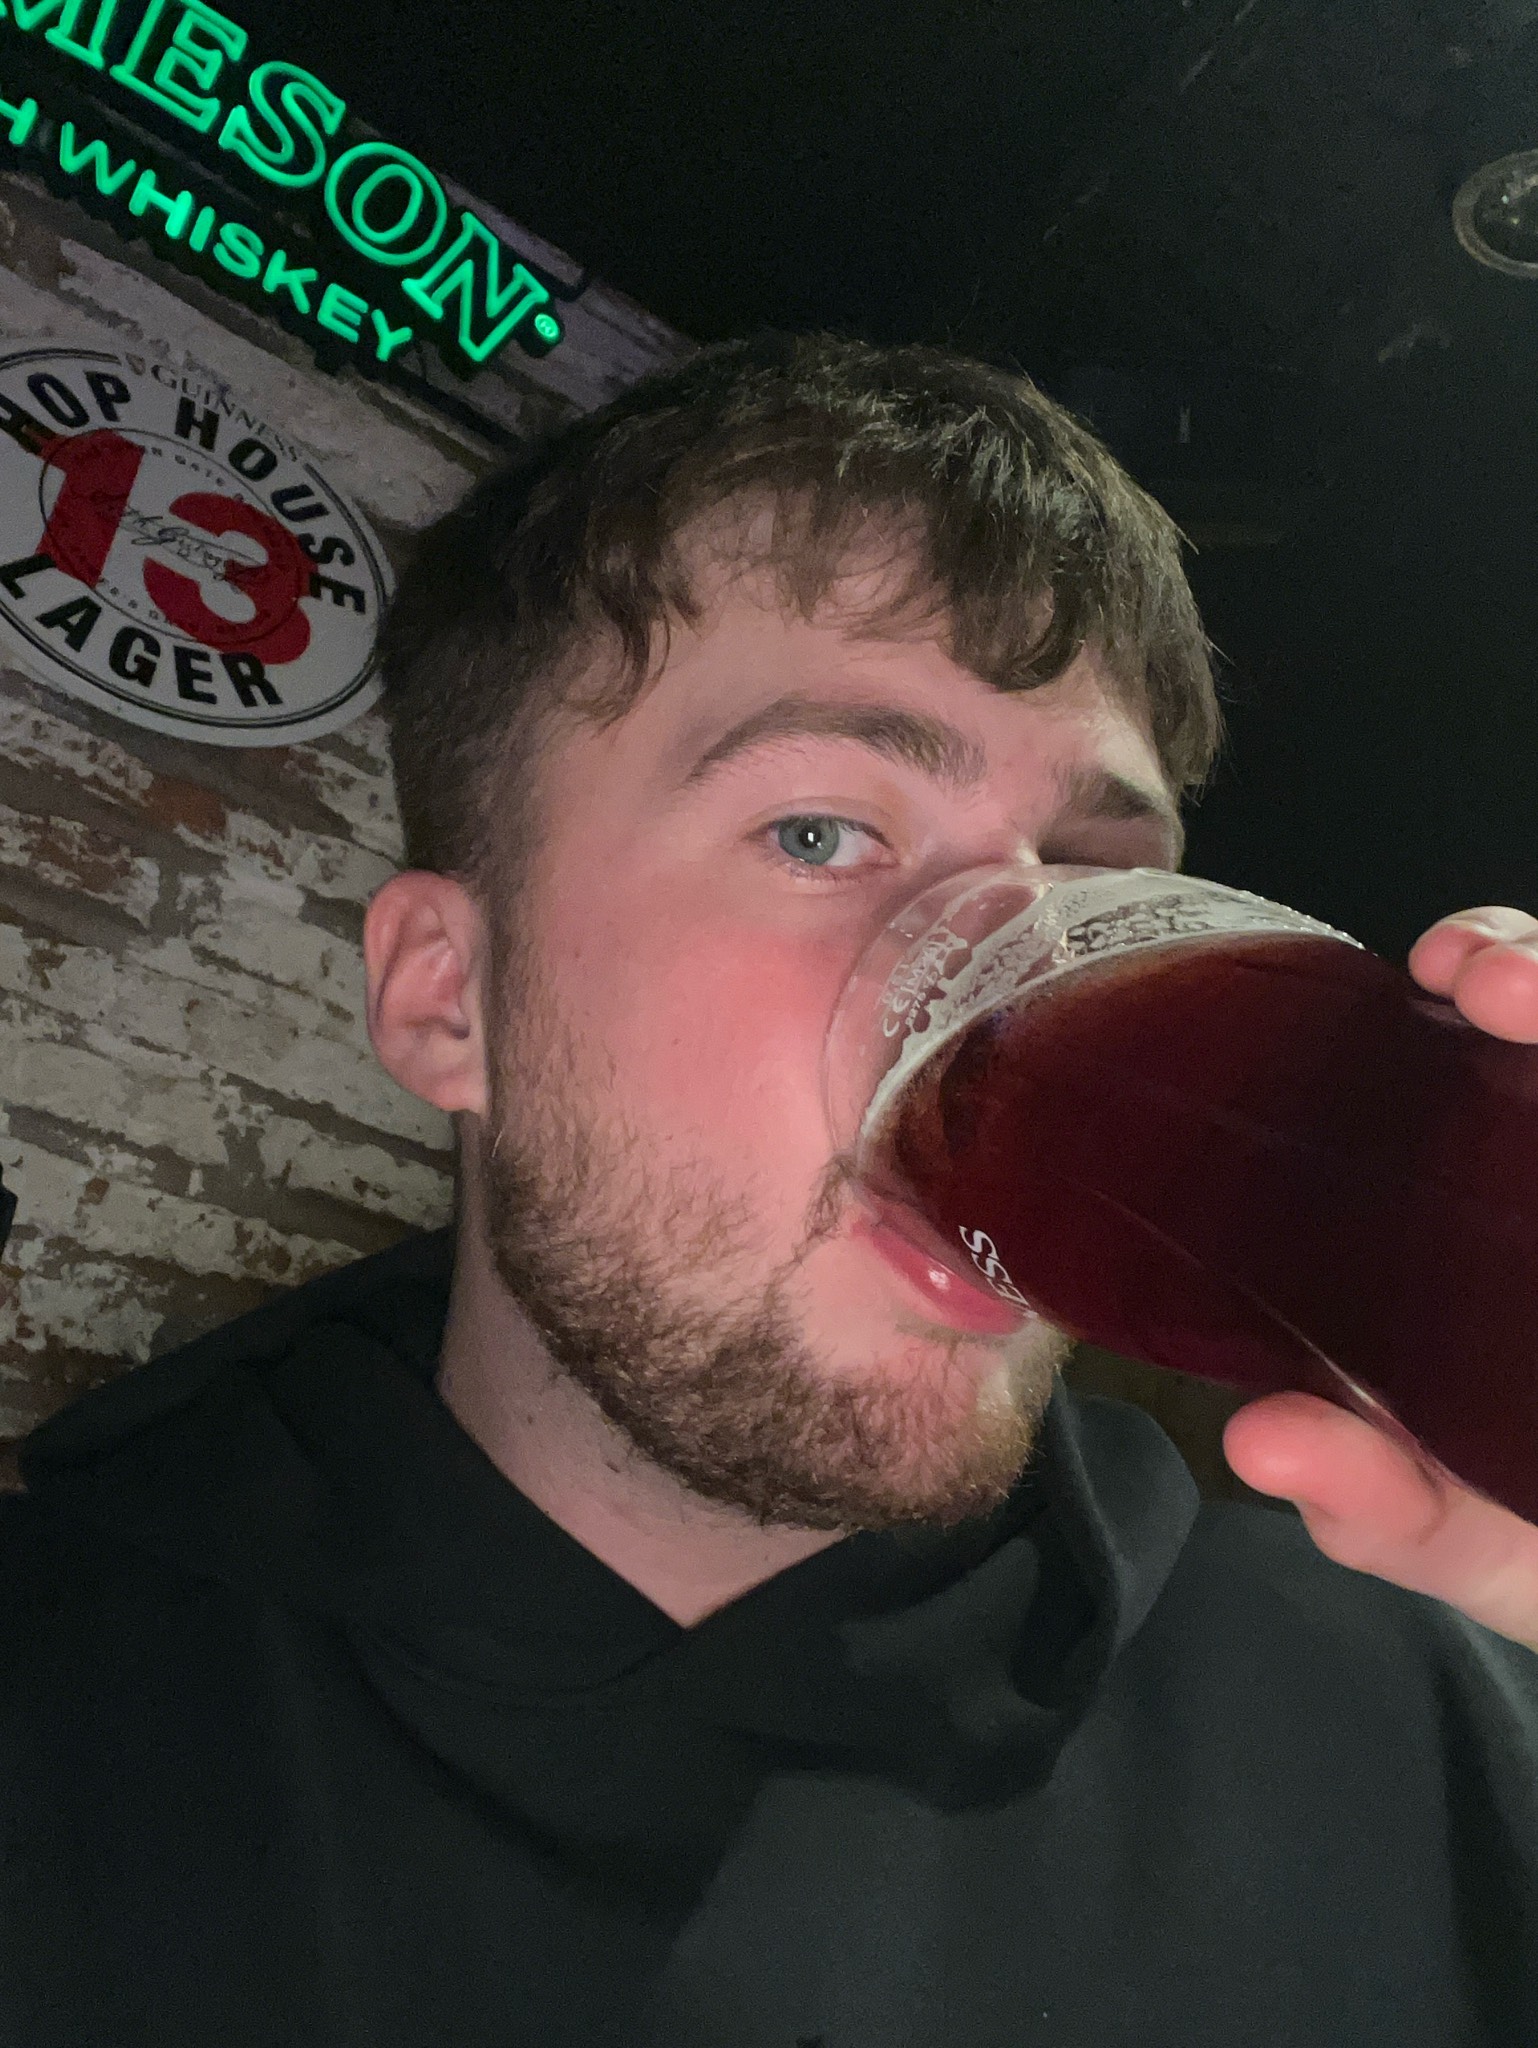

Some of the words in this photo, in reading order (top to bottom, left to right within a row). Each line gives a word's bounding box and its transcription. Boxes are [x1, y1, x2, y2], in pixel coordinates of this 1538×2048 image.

[60, 122, 412, 362] WHISKEY
[0, 371, 131, 456] HOP
[174, 396, 367, 616] HOUSE
[37, 428, 312, 666] 13
[0, 553, 284, 709] LAGER
